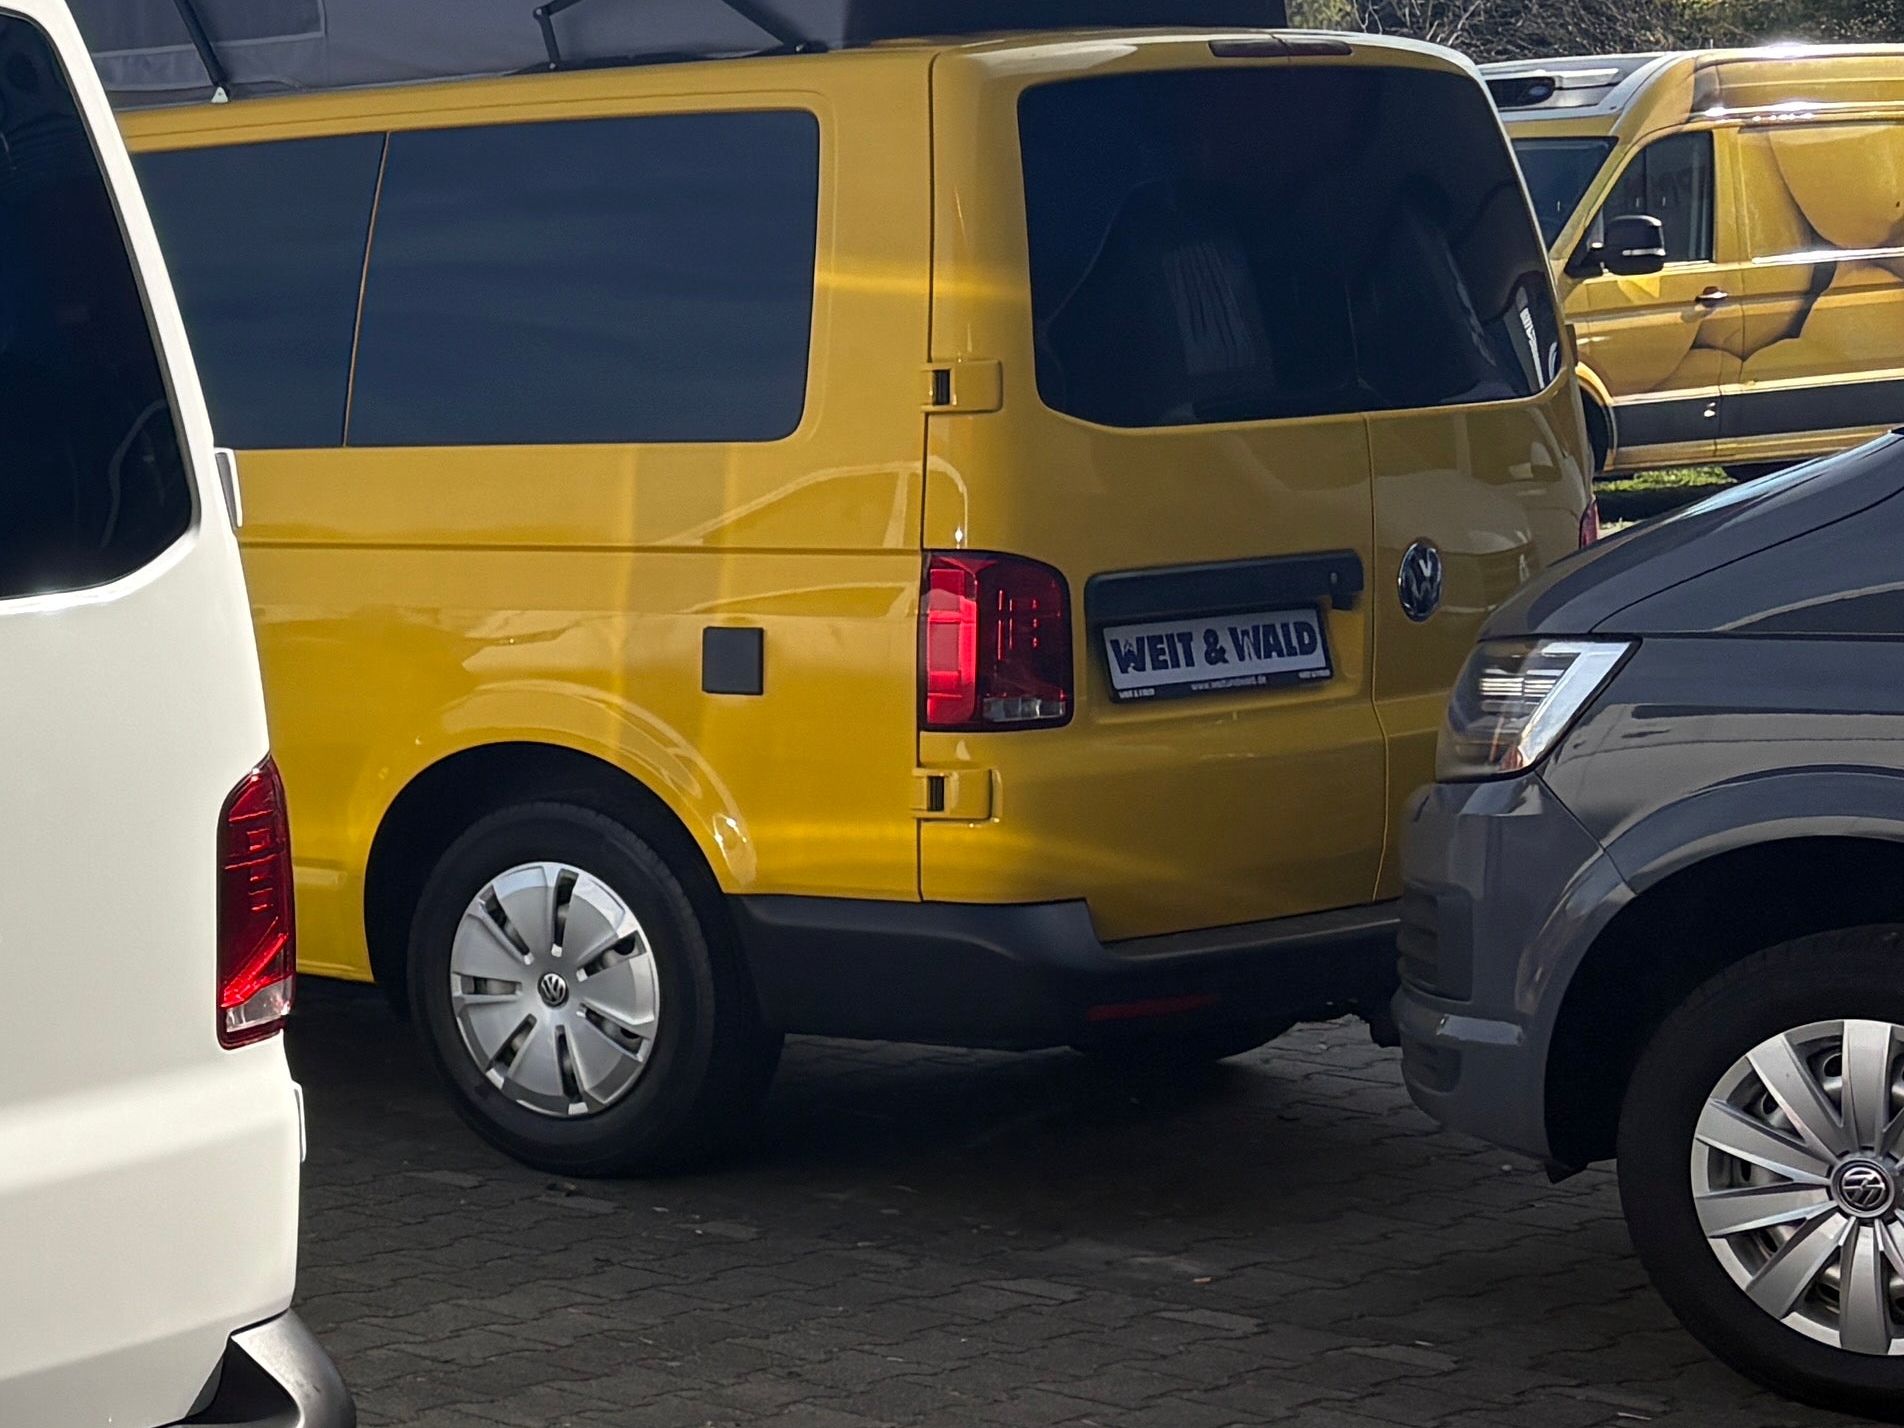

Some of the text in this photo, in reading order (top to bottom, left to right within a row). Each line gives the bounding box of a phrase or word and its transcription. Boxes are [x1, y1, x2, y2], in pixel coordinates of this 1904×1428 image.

[1109, 620, 1319, 675] WEIT & WALD
